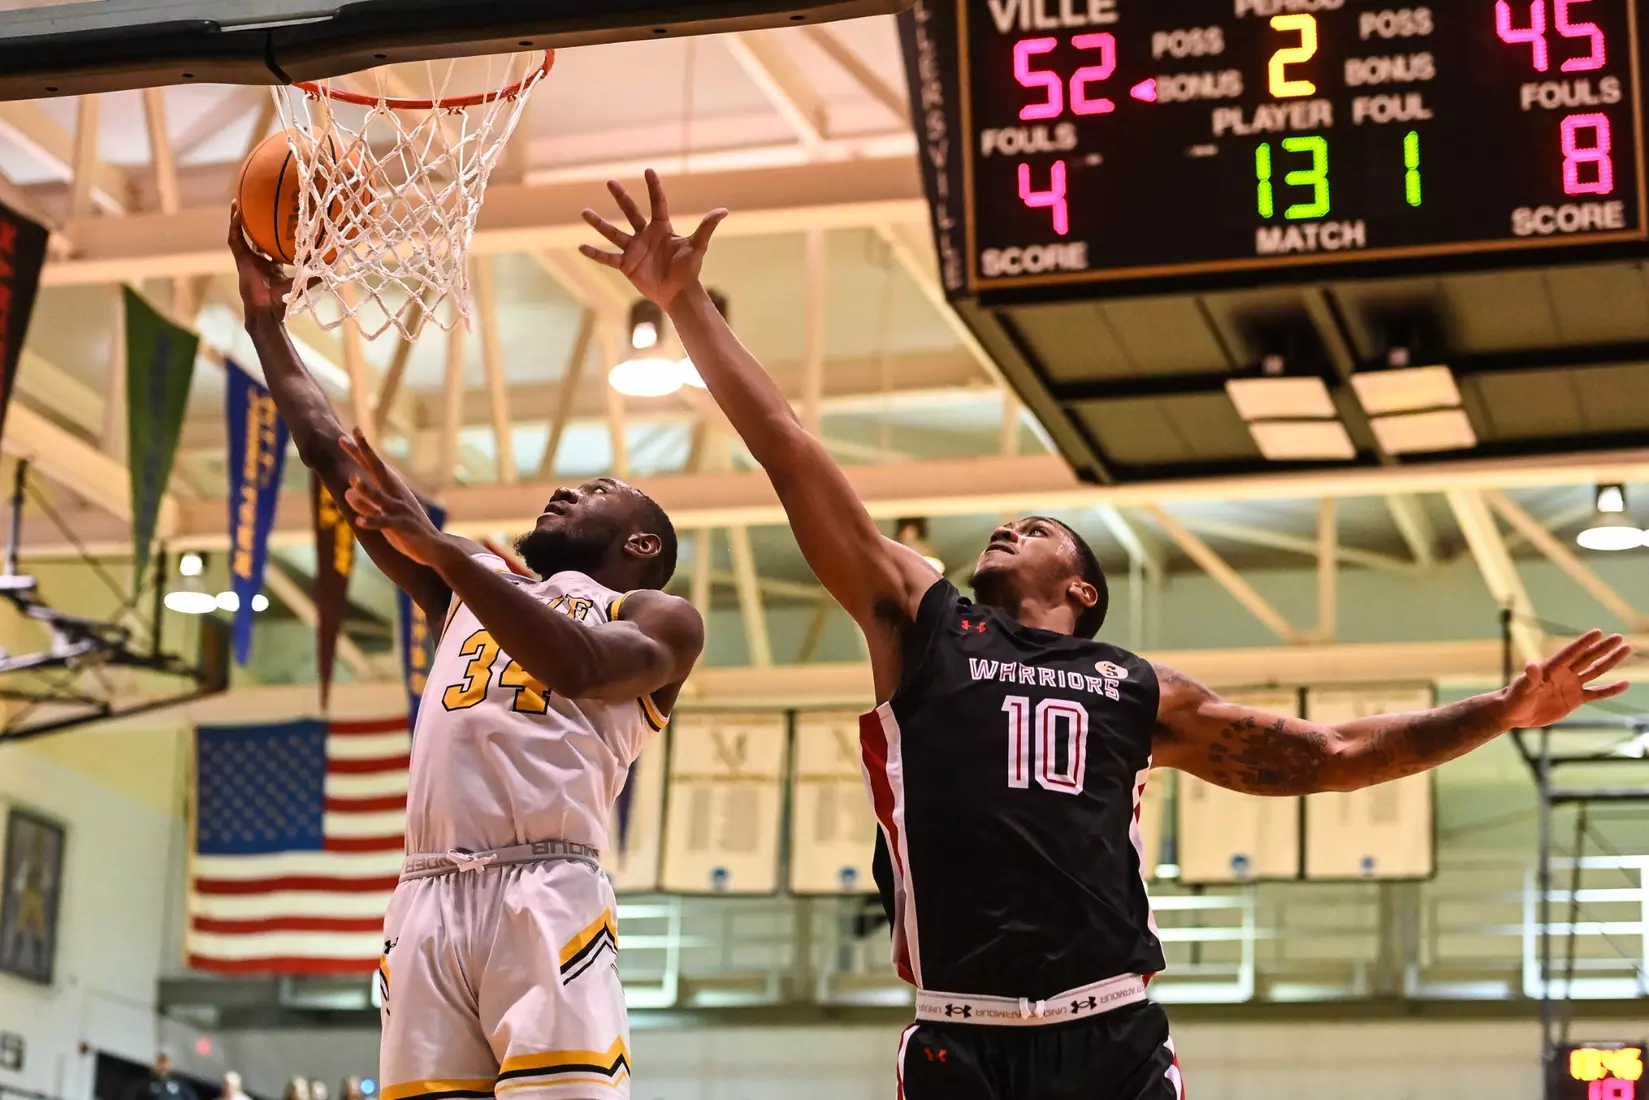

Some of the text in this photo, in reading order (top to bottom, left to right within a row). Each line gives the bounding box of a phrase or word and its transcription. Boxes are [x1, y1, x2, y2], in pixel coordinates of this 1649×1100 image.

[988, 0, 1119, 33] VILLE
[1358, 6, 1435, 40] POSS
[1495, 0, 1606, 72] 45
[1152, 25, 1225, 60] POSS
[1268, 13, 1318, 98] 2
[1013, 32, 1117, 120] 52
[1156, 69, 1243, 103] BONUS
[1344, 52, 1436, 87] BONUS
[1212, 92, 1434, 136] PLAYER FOUL
[1520, 75, 1622, 111] FOULS
[980, 122, 1078, 156] FOULS
[1560, 112, 1614, 195] 8
[1255, 135, 1331, 220] 13
[1403, 130, 1422, 207] 1
[1017, 159, 1069, 235] 4
[1511, 200, 1626, 237] SCORE
[1255, 220, 1367, 255] MATCH
[980, 242, 1088, 277] SCORE
[441, 629, 551, 715] 34
[969, 658, 1119, 701] WARRIORS
[1001, 695, 1089, 795] 10
